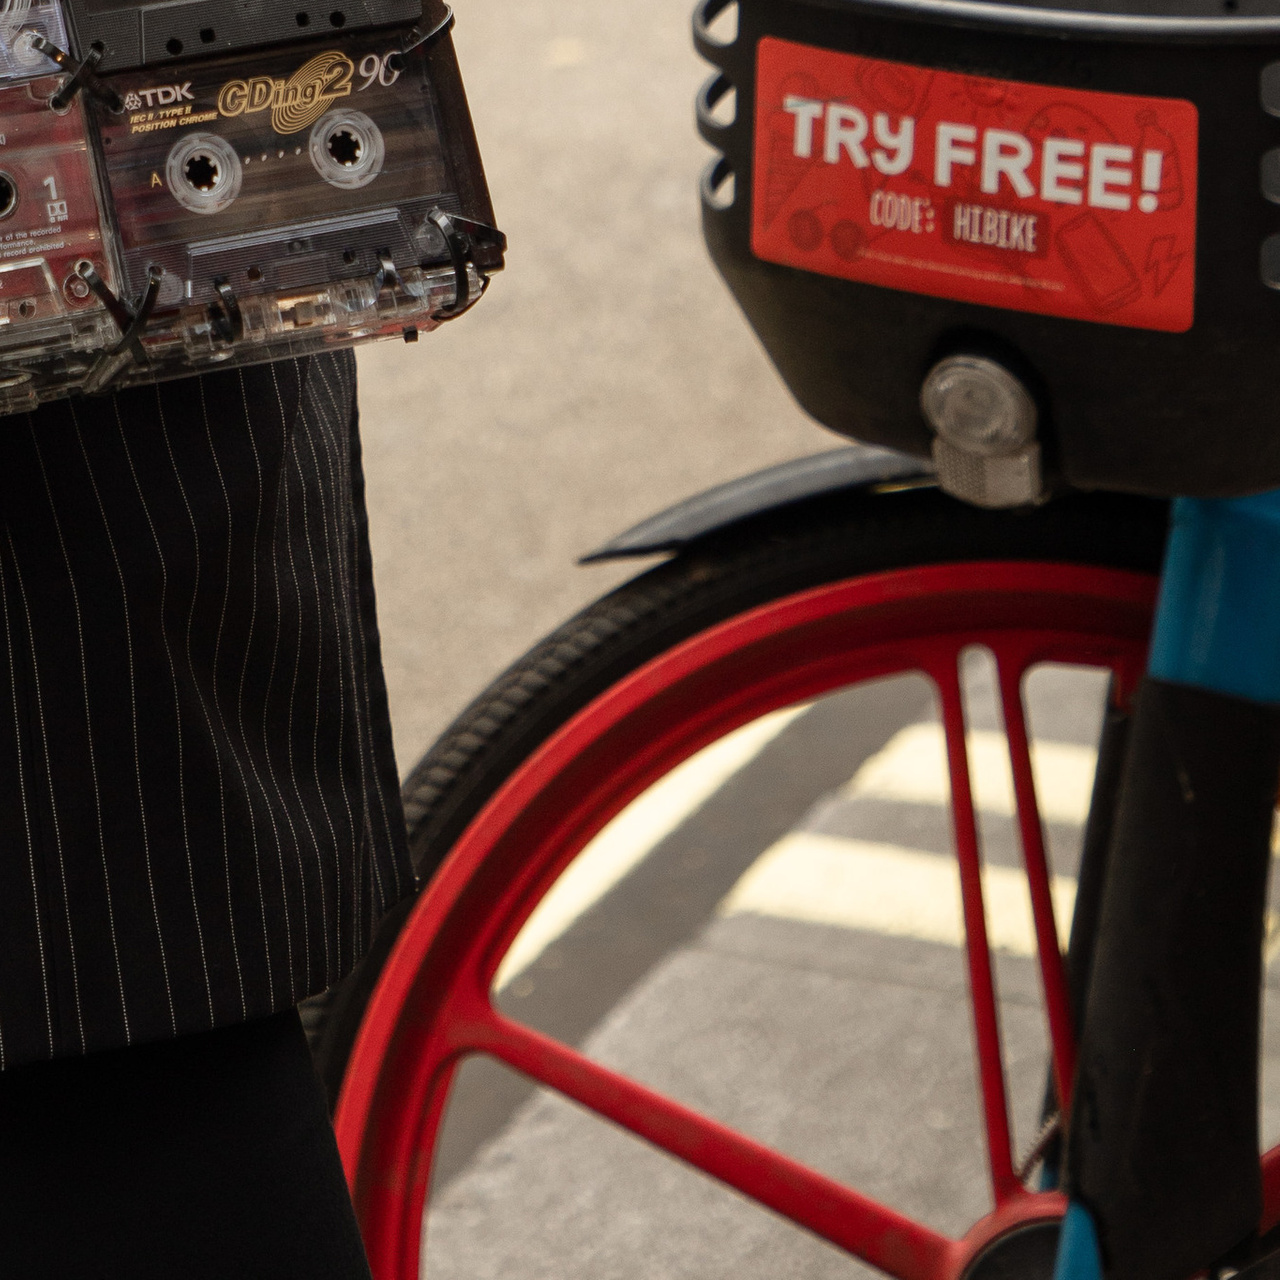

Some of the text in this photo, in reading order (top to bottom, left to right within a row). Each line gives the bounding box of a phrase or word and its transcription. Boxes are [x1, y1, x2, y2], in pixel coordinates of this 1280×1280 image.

[357, 52, 400, 92] 90
[138, 83, 195, 108] TDK
[130, 113, 146, 123] IEC
[131, 112, 218, 133] POSITION CHROME
[783, 94, 1163, 212] TRY FREE!
[43, 175, 58, 201] 1
[151, 172, 162, 188] A
[5, 234, 12, 242] of
[15, 232, 26, 240] the
[30, 226, 61, 238] recorded
[953, 202, 1038, 252] HIBIKE
[4, 248, 26, 258] record
[28, 242, 64, 255] prohibited
